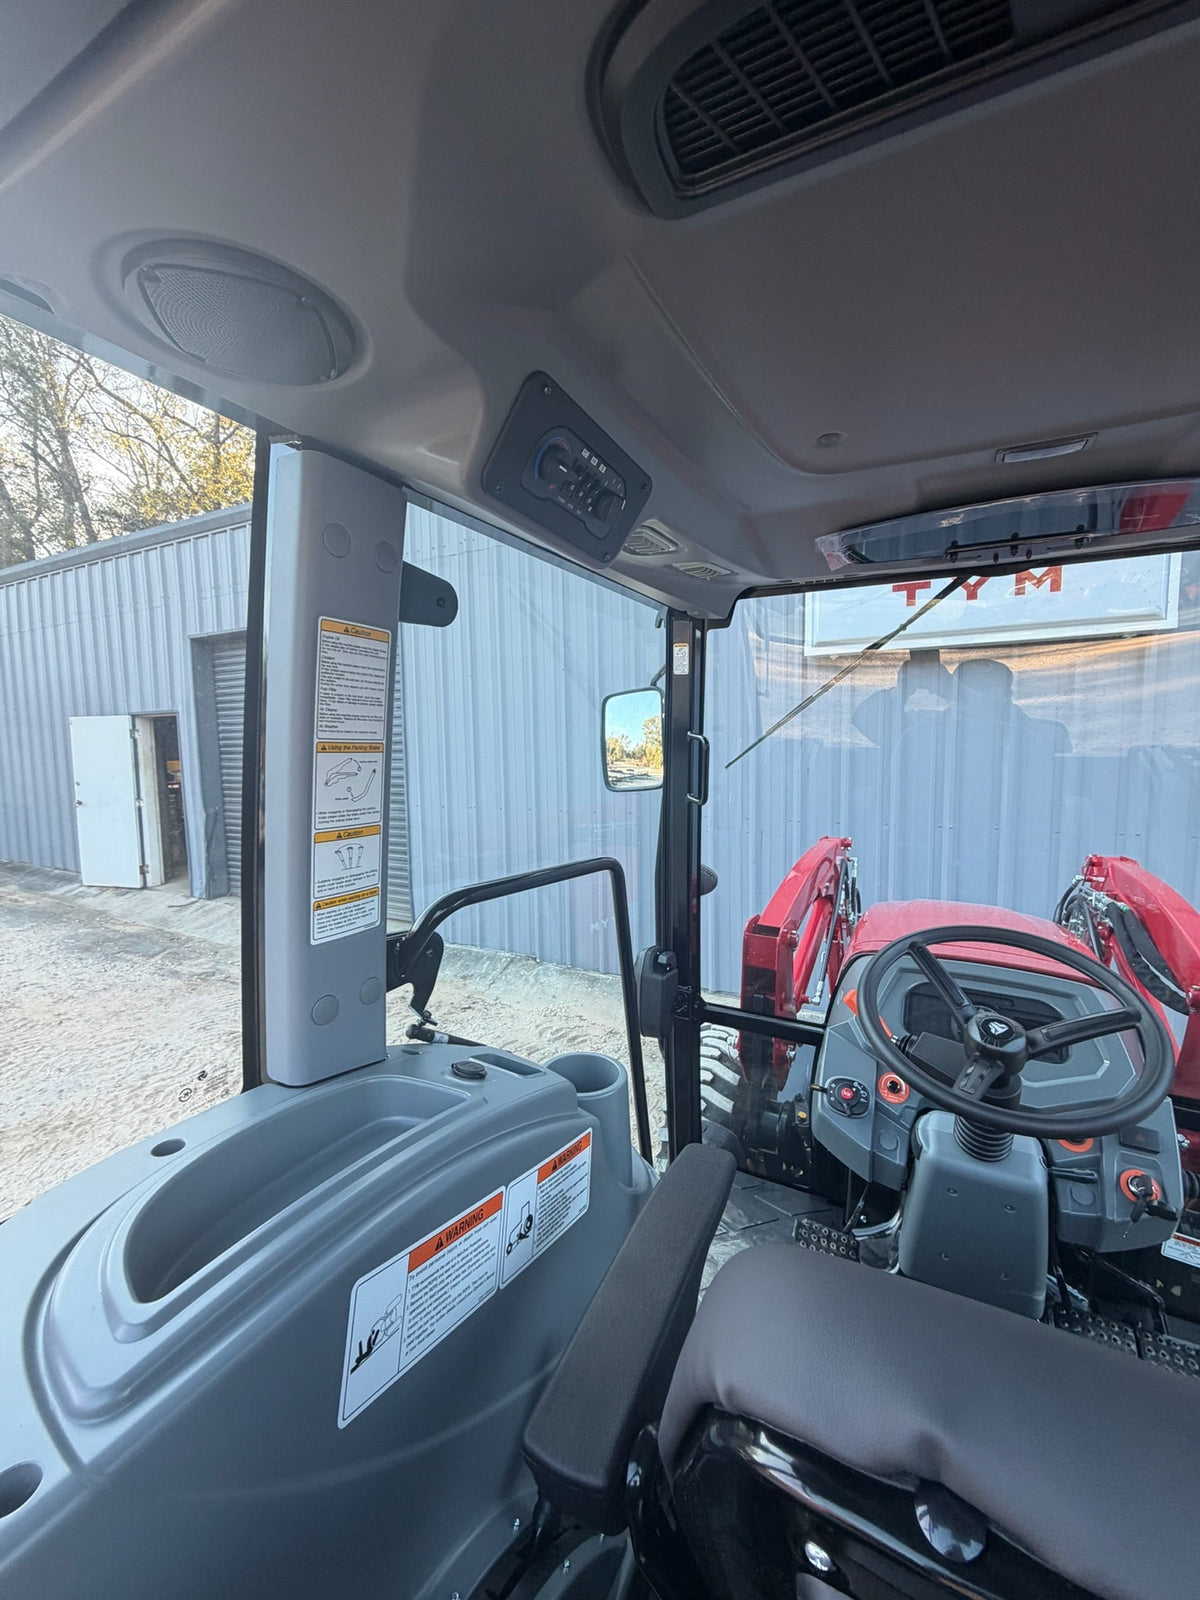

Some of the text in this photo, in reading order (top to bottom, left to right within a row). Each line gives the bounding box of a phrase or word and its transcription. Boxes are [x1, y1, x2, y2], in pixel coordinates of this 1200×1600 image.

[892, 566, 1063, 606] TYM
[350, 626, 372, 638] Caution
[343, 829, 364, 838] Caution
[557, 1140, 583, 1168] WARNING
[445, 1208, 484, 1243] WARNING
[416, 1265, 428, 1278] avoid
